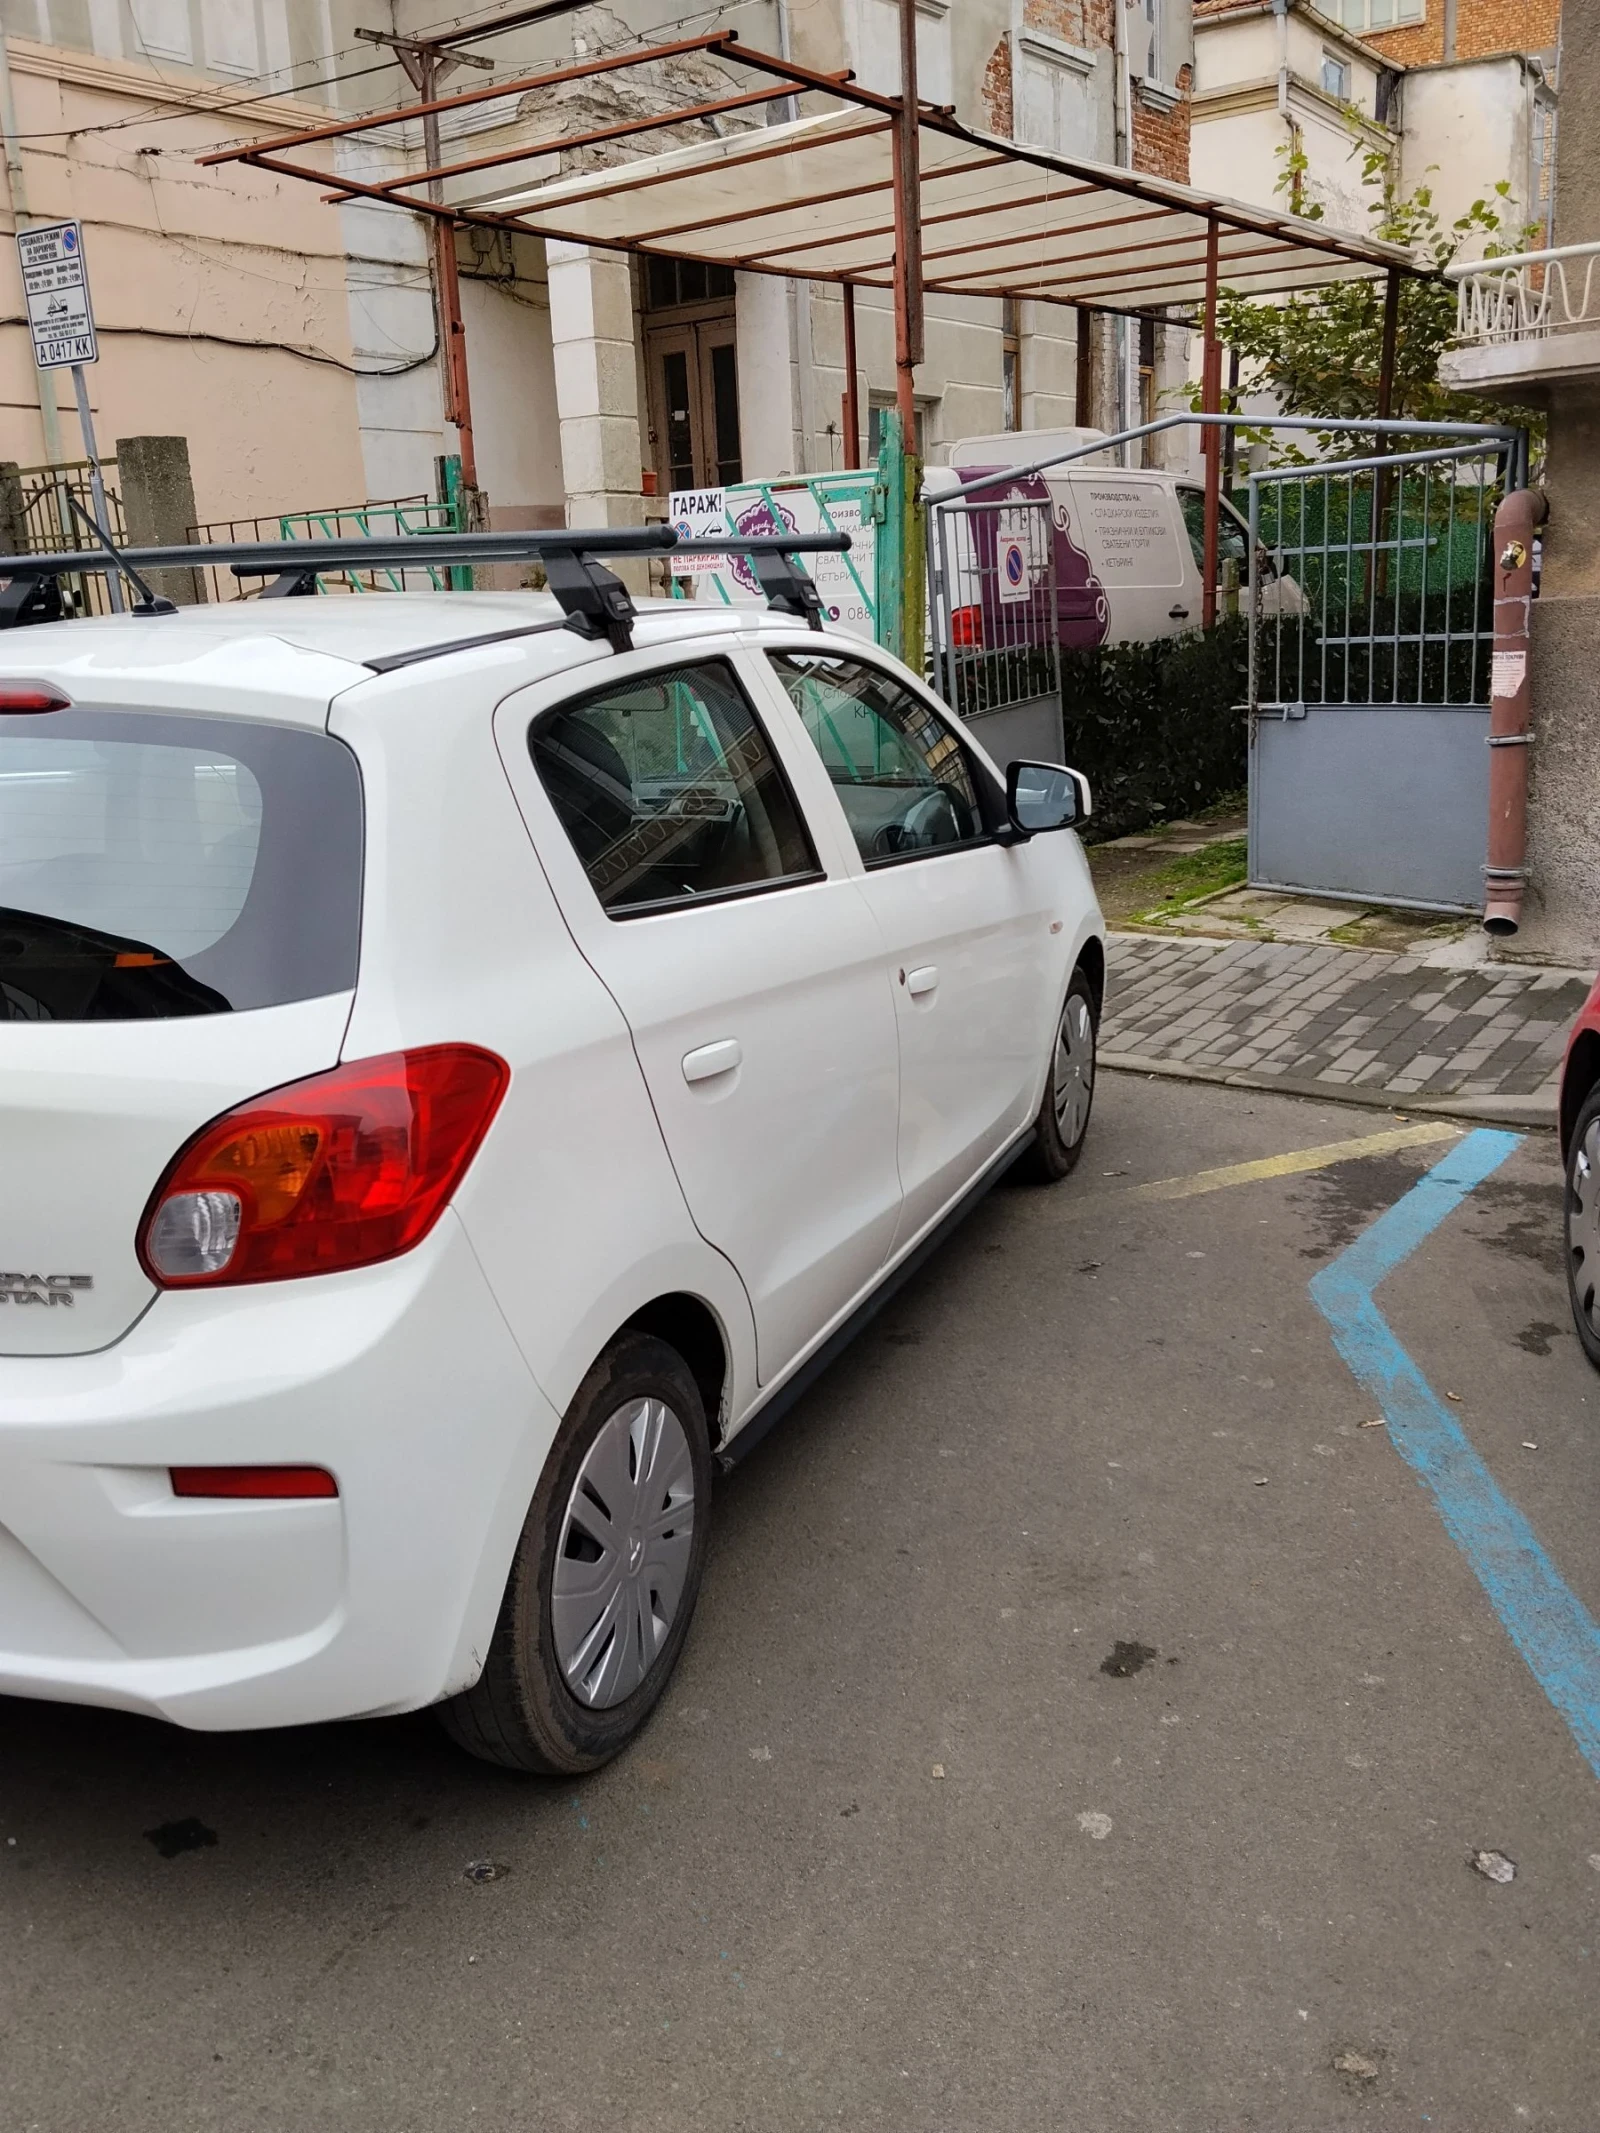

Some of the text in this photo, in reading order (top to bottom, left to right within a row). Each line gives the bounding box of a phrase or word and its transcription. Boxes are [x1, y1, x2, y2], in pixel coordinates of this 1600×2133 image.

[40, 345, 47, 362] A
[49, 340, 72, 361] 0417
[673, 493, 722, 516] ГАРАЖ!
[817, 553, 866, 565] СВАТБНИ
[817, 570, 864, 582] КЕТЪРИГ
[0, 1272, 93, 1289] PACE
